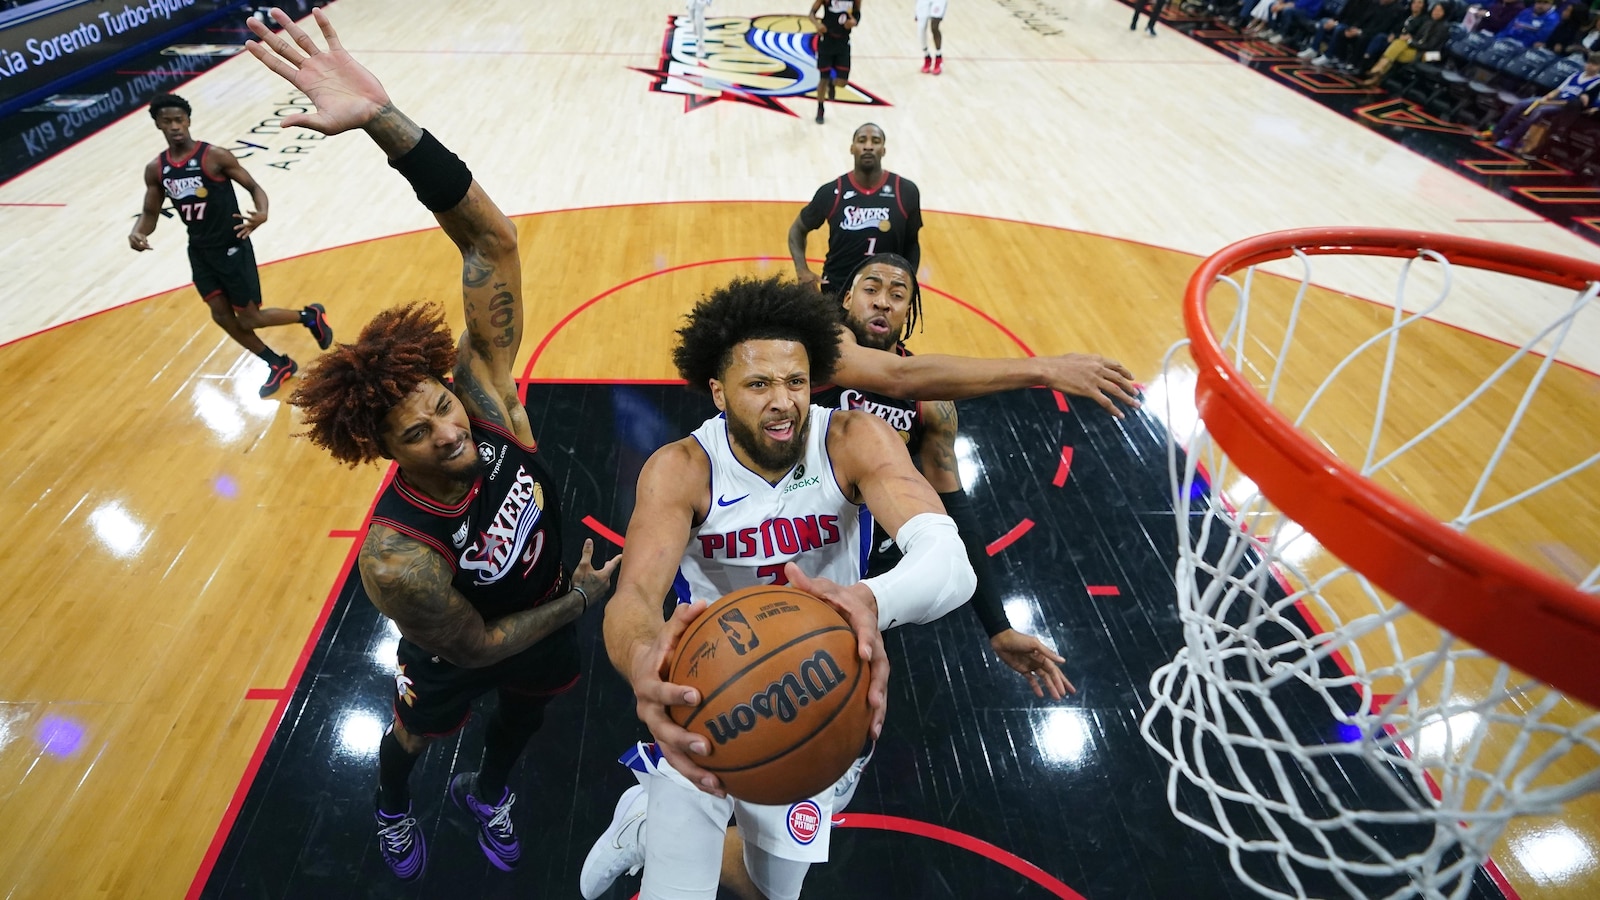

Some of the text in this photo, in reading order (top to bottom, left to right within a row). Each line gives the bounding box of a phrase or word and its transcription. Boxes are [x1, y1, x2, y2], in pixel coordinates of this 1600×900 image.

[26, 22, 101, 66] Sorento
[98, 0, 195, 37] Turbo-Hybr
[266, 133, 327, 171] ARE
[181, 202, 207, 221] 77
[863, 237, 877, 256] 1
[840, 389, 917, 431] SXERS
[490, 444, 508, 480] crypto.com
[452, 520, 468, 545] NIKE
[459, 465, 535, 577] SIXERS
[697, 514, 841, 559] PISTONS
[522, 529, 545, 579] 9
[704, 649, 846, 745] Wilson
[794, 819, 816, 832] PISTONS
[795, 812, 817, 824] DETROIT
